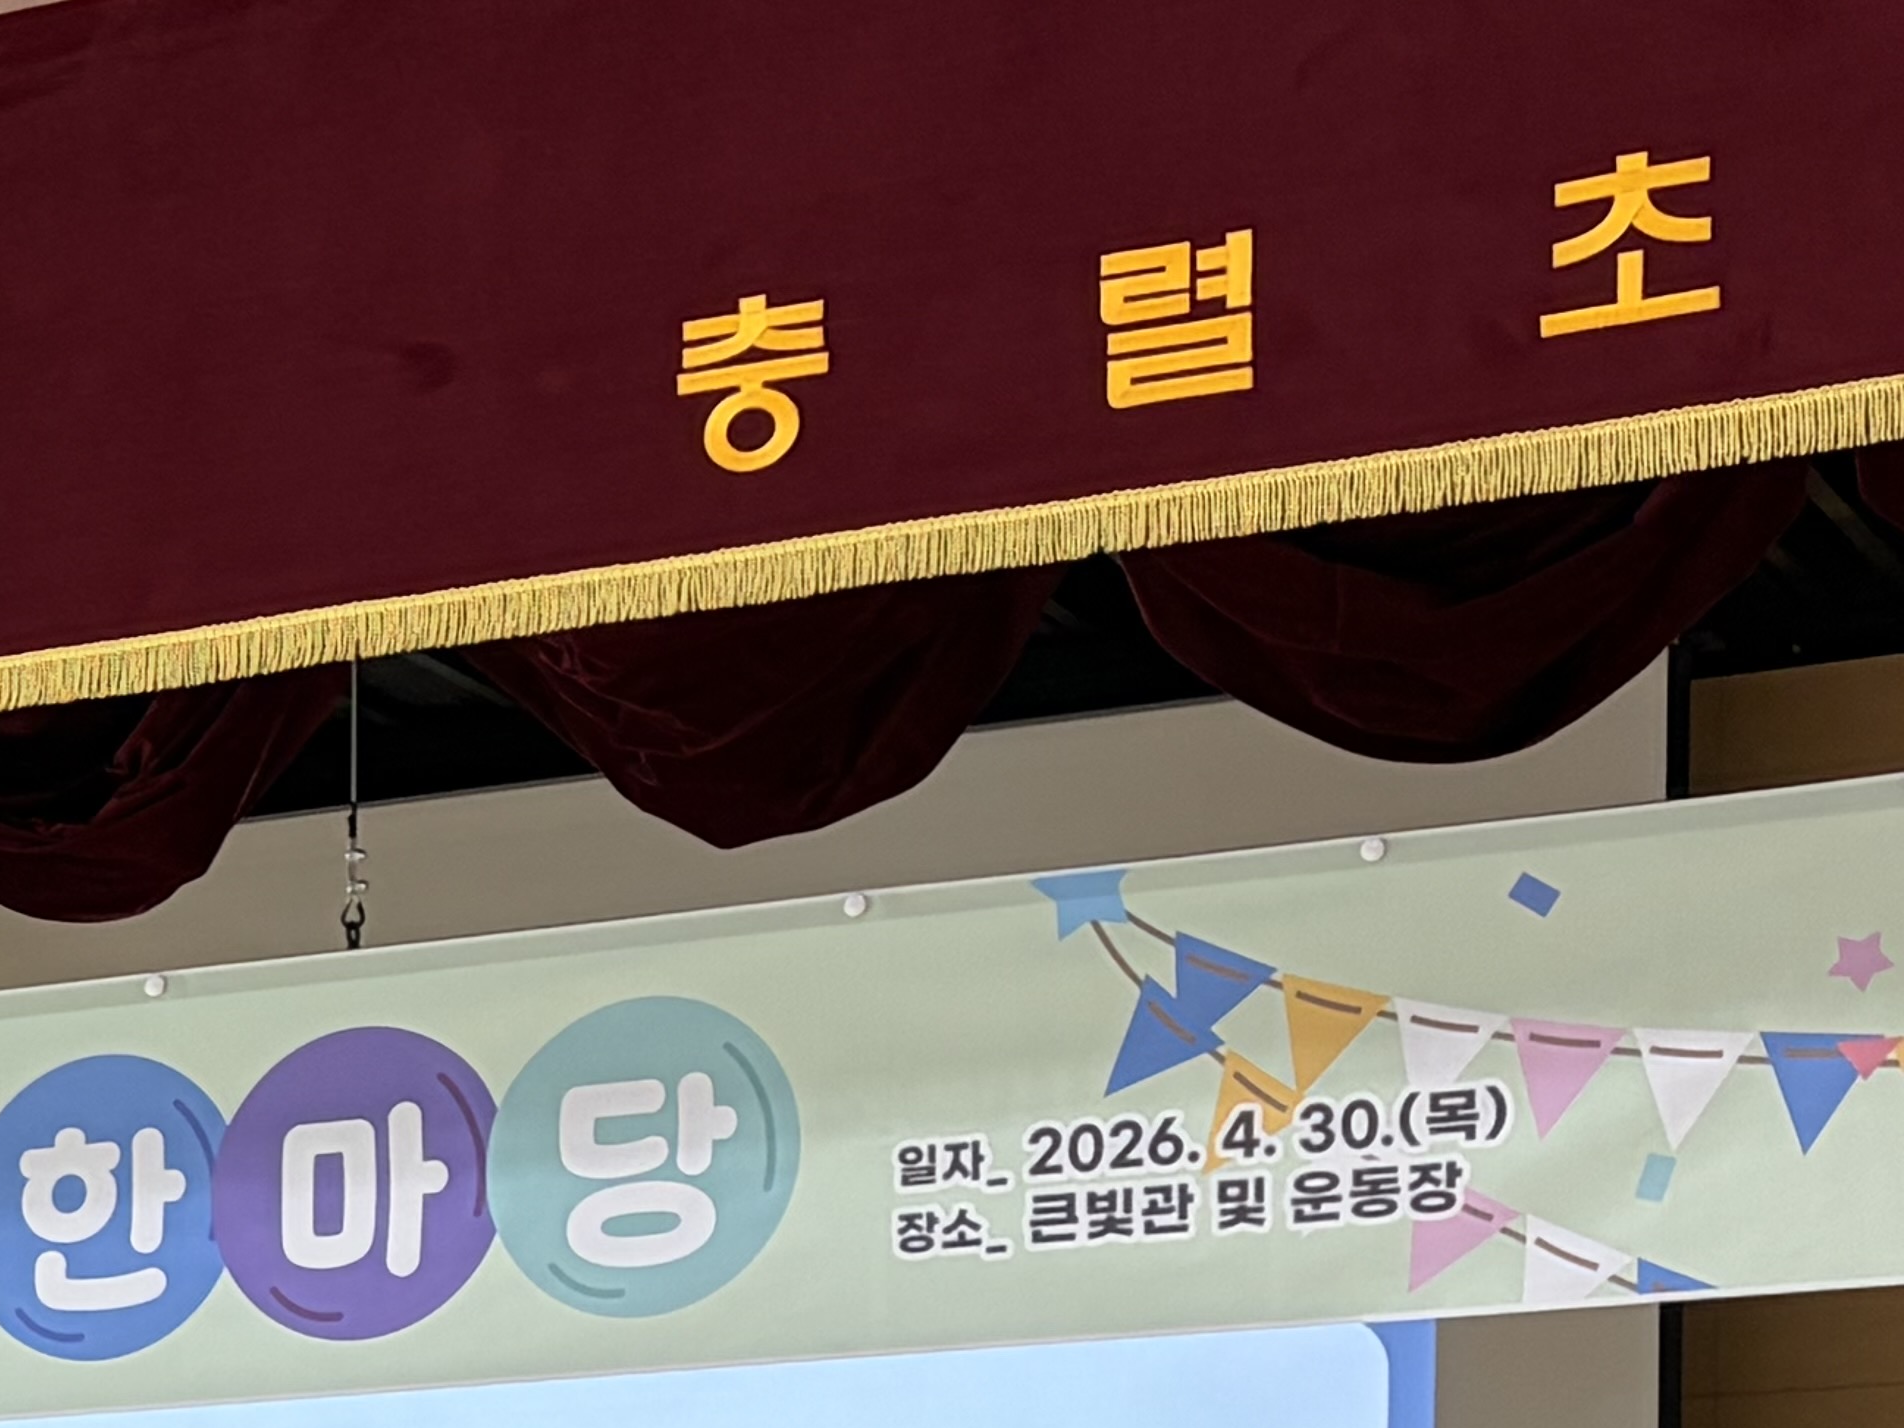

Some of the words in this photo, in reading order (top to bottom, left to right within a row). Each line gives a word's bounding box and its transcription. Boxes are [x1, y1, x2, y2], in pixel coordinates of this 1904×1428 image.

[677, 294, 830, 473] 충
[1099, 229, 1254, 409] 렬
[1539, 150, 1722, 338] 초
[897, 1141, 1008, 1187] 일자_
[1028, 1116, 1200, 1176] 2026.
[1222, 1111, 1277, 1158] 4.
[1299, 1086, 1508, 1154] 30.(목)
[897, 1209, 1008, 1254] 장소_
[1029, 1183, 1194, 1244] 큰빛관
[1216, 1177, 1266, 1229] 및
[1292, 1162, 1464, 1224] 운동장
